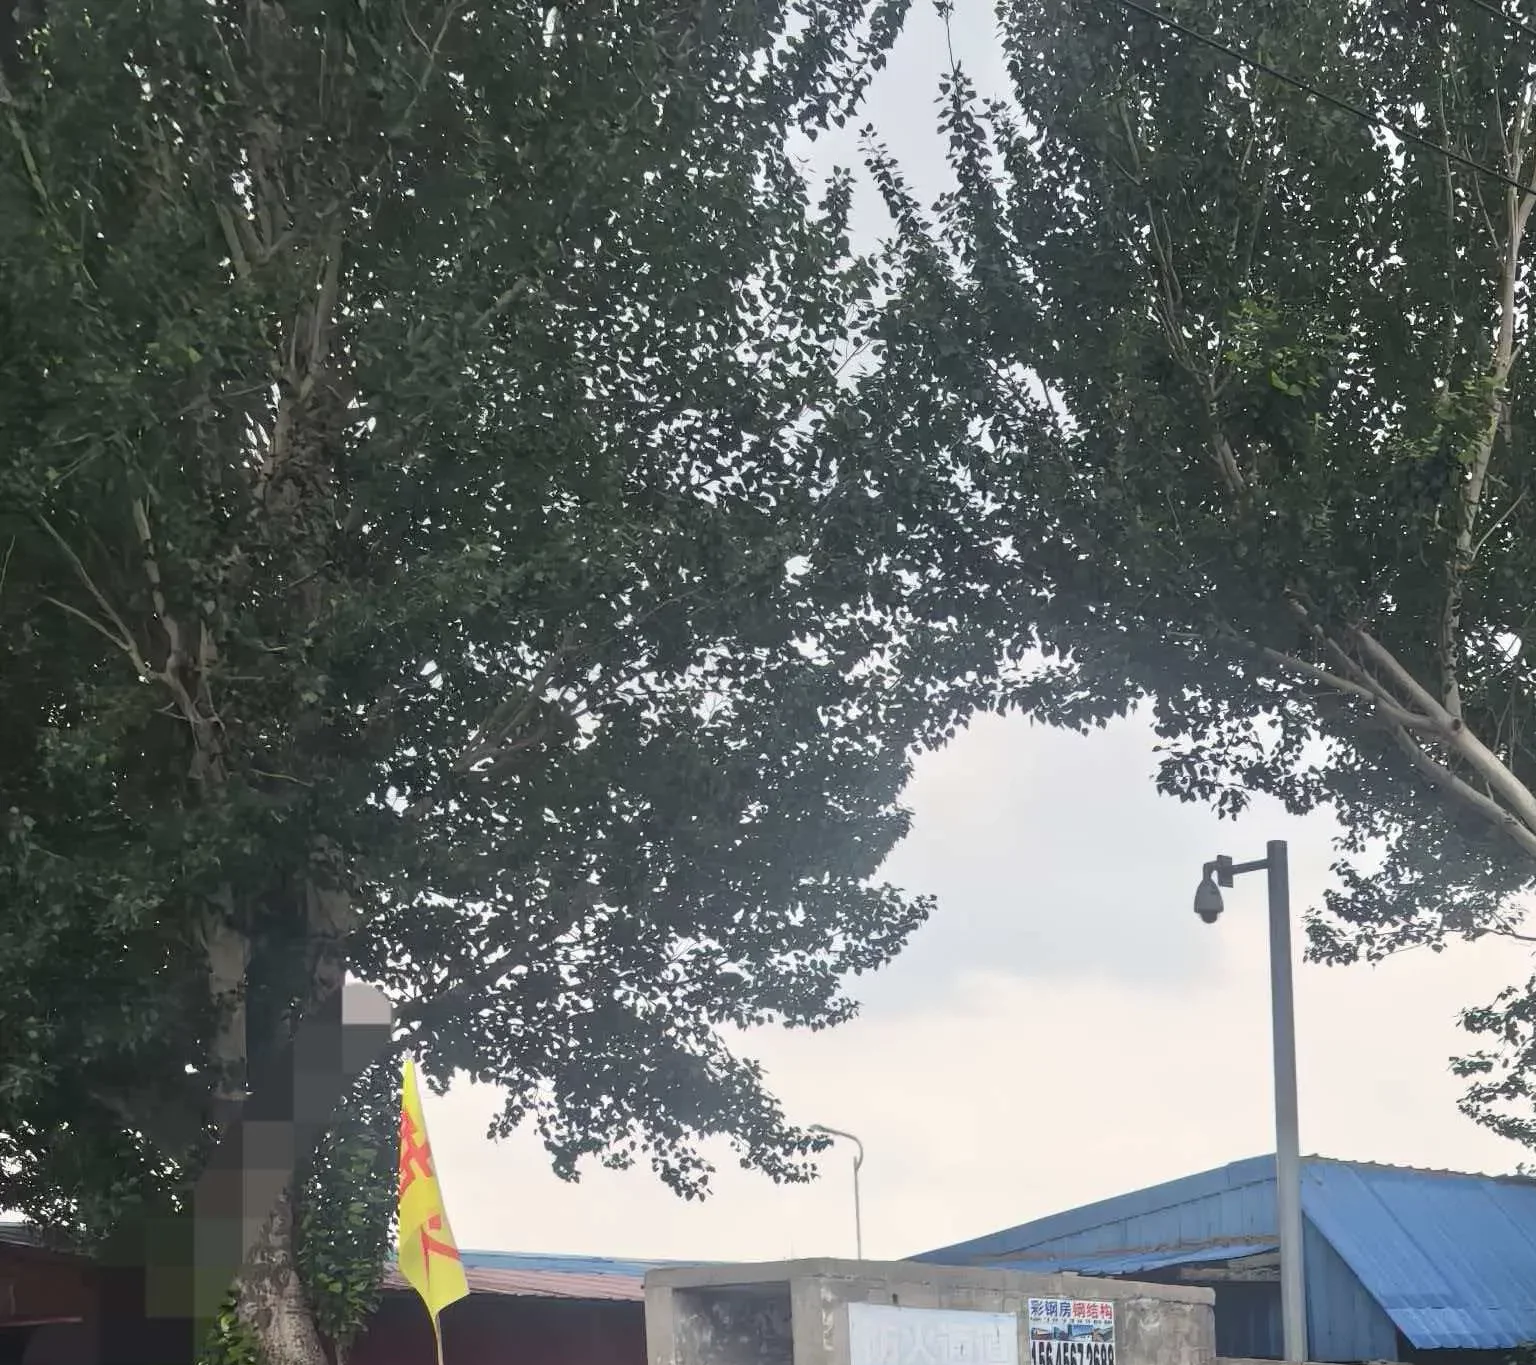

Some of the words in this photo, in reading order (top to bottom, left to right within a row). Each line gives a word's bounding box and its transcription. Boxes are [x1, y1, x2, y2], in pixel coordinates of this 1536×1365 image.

[1030, 1300, 1113, 1320] 彩钢房钢结构
